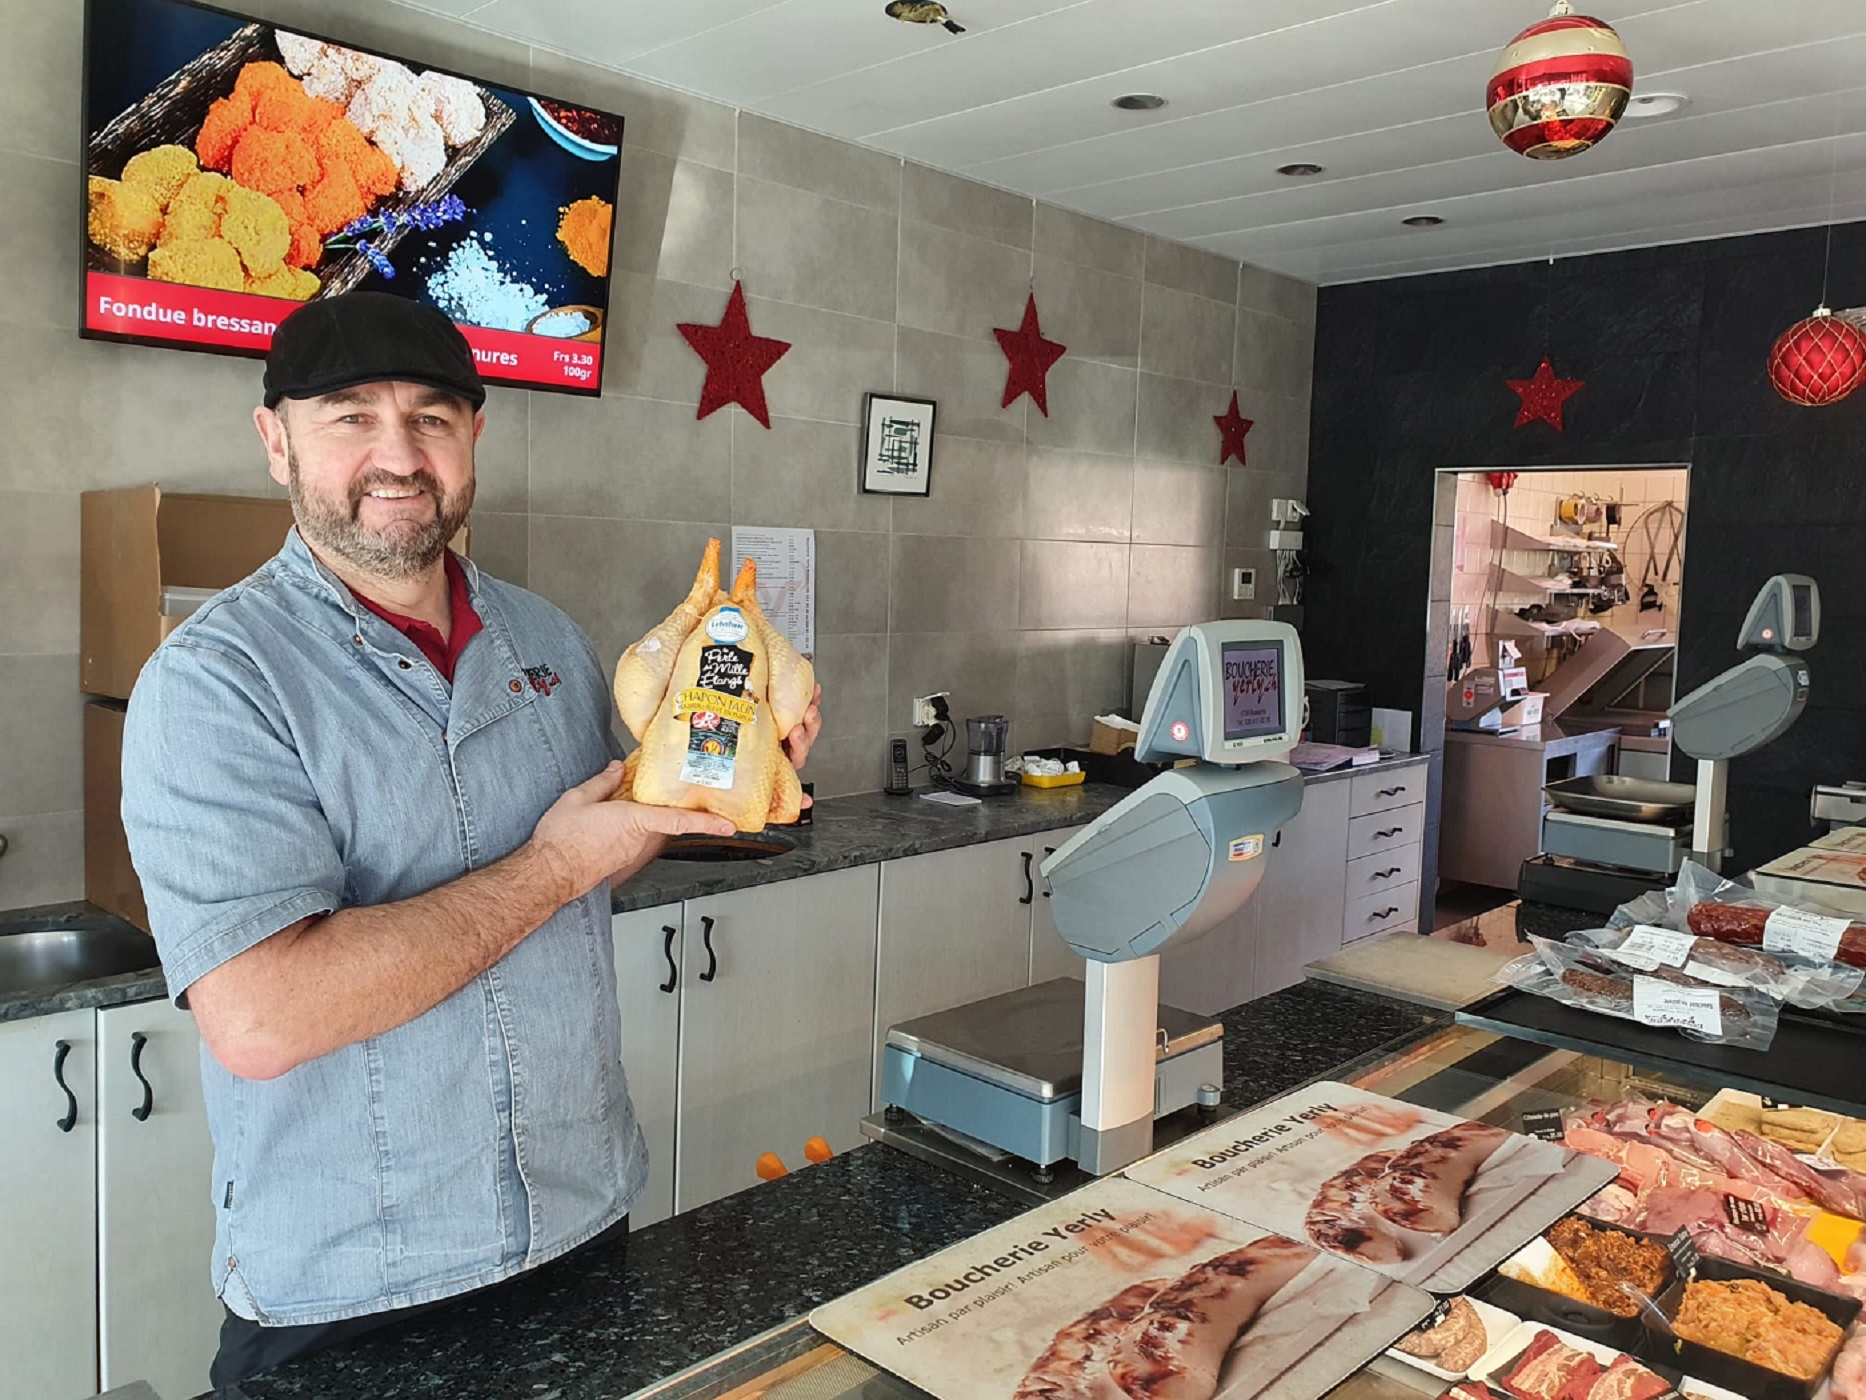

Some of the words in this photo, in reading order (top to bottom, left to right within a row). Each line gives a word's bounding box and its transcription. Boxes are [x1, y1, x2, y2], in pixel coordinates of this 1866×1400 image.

[99, 296, 186, 324] Fondue
[553, 351, 570, 362] Frs
[572, 353, 593, 366] 3.30
[563, 365, 592, 381] 100gr
[1225, 660, 1274, 681] BOUCHERIE
[675, 691, 726, 707] CHAPON
[1191, 1124, 1292, 1169] Boucherie
[1282, 1103, 1338, 1125] Yerly
[1197, 1174, 1233, 1192] Artisan
[904, 1240, 1050, 1310] Boucherie
[1042, 1208, 1116, 1240] Yerly
[897, 1318, 949, 1346] Artisan
[949, 1304, 973, 1321] par
[973, 1281, 1018, 1309] plaisir!
[1017, 1259, 1062, 1284] Artisan
[1062, 1246, 1089, 1264] pour
[1089, 1231, 1121, 1248] votre
